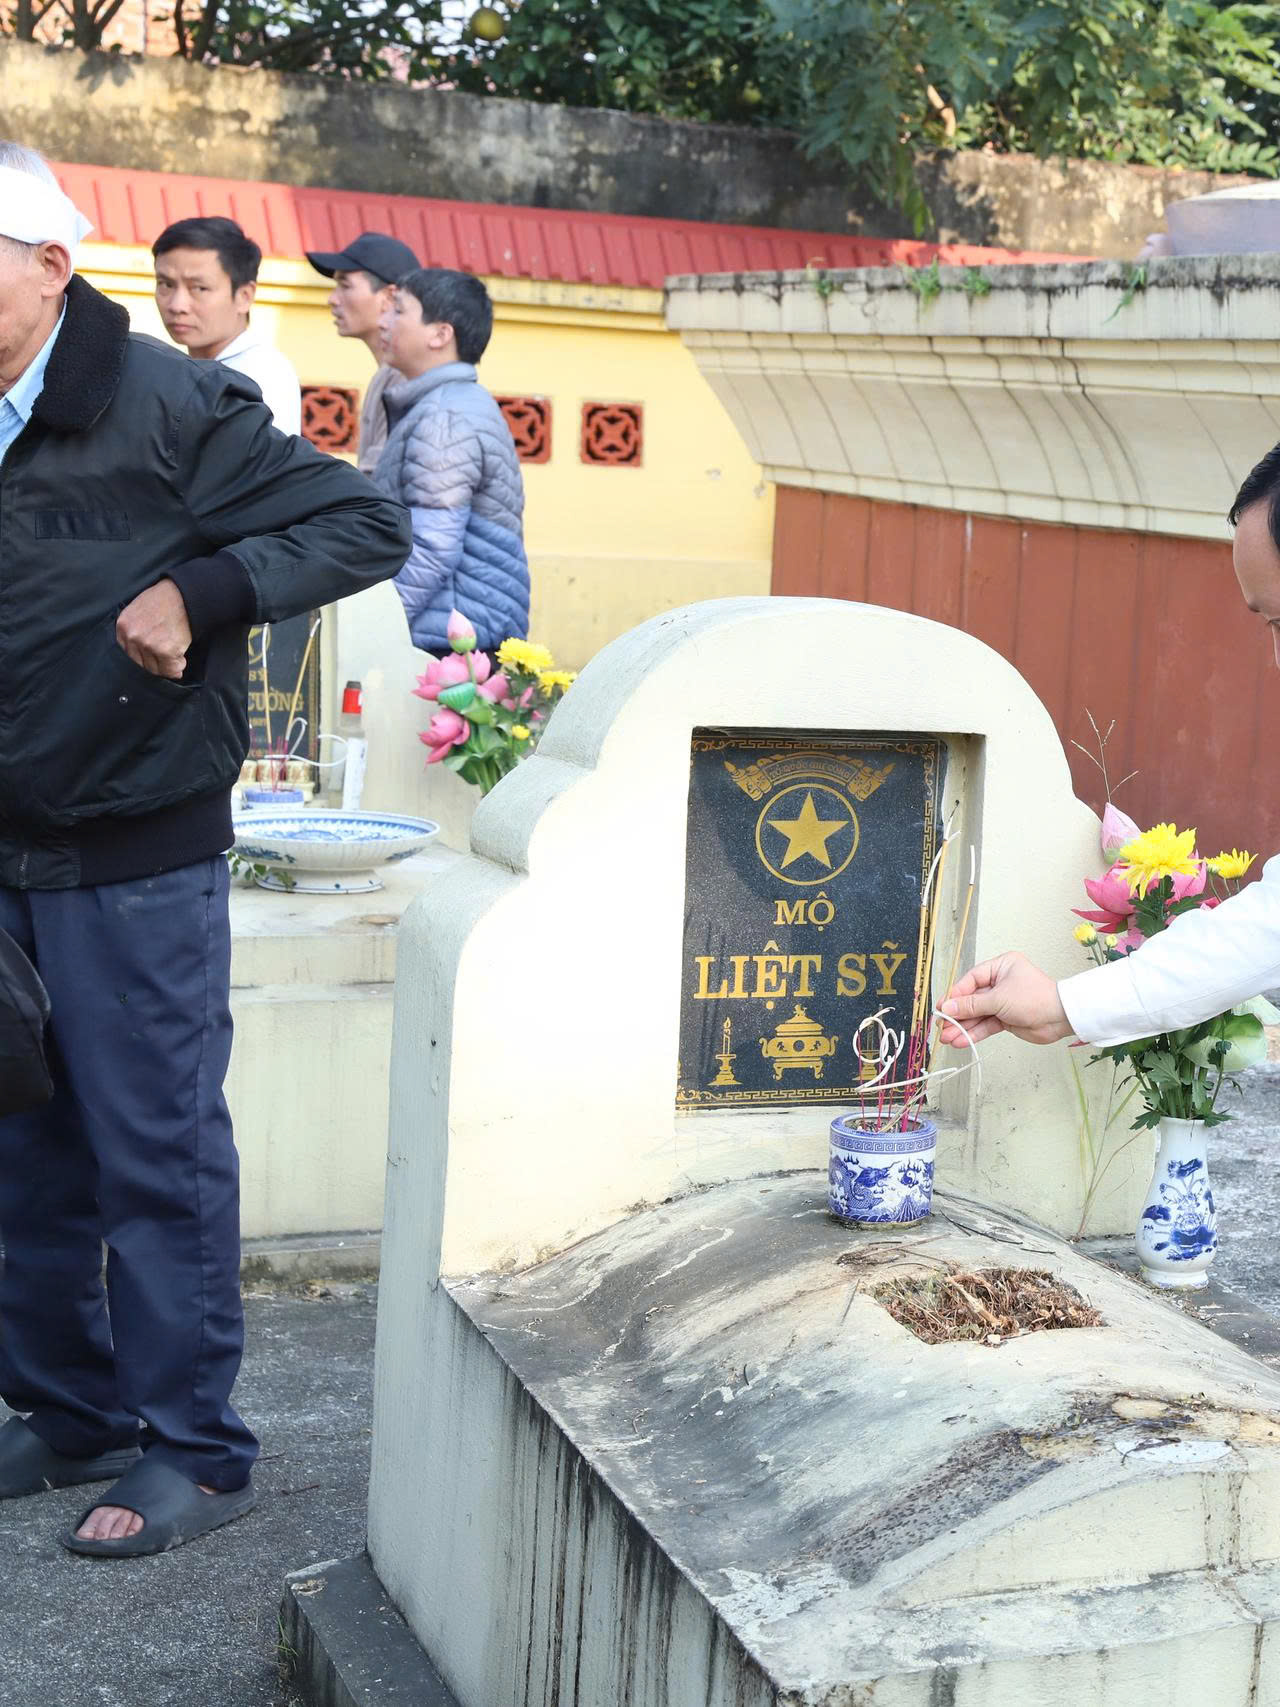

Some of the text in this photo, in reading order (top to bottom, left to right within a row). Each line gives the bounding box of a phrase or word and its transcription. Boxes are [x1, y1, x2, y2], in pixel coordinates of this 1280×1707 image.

[774, 891, 835, 932] MỘ
[694, 940, 907, 1009] LIỆT SỸ
